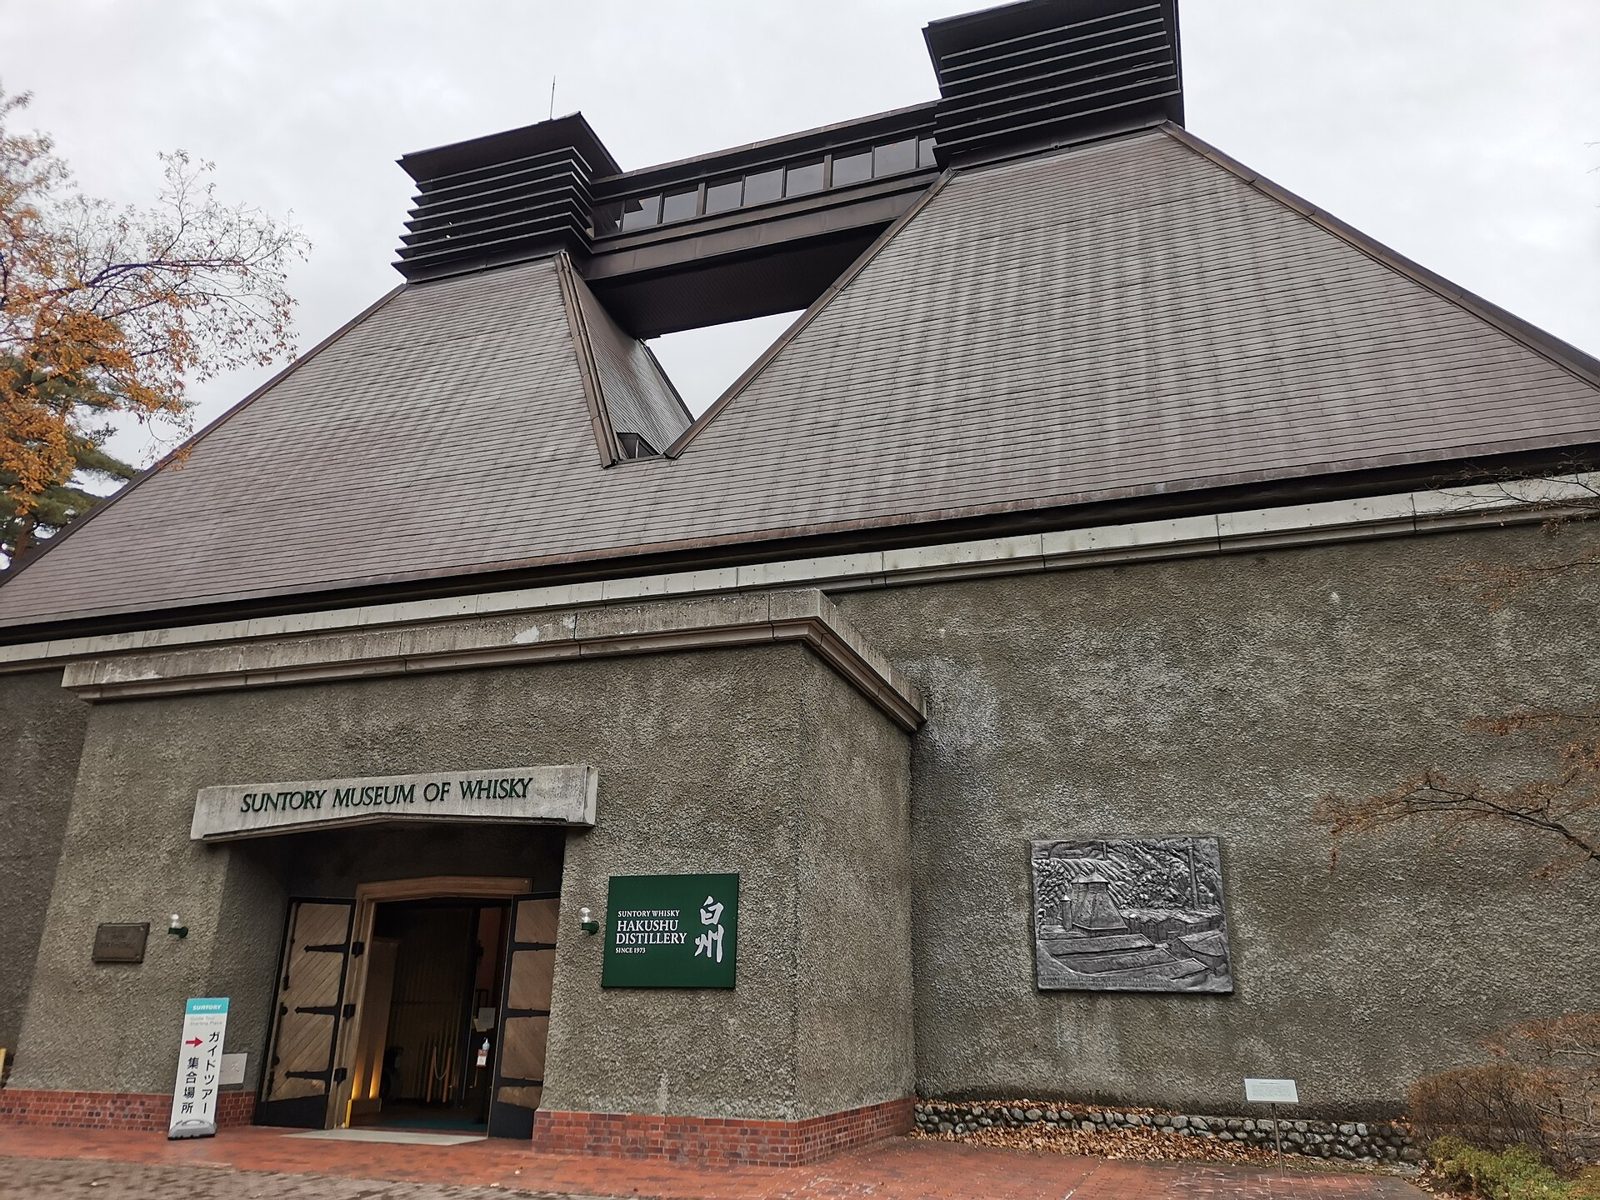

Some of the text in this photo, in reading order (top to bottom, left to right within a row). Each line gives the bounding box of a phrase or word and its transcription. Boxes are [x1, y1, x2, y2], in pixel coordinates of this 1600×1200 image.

[240, 777, 534, 813] SUNTORY MUSEUM OF WHISKY
[617, 909, 680, 918] SUNTORY WHISKY
[616, 920, 679, 932] HAKUSHU
[694, 895, 725, 963] 白州
[615, 932, 688, 945] DISTILLERY
[192, 1003, 222, 1011] SUNTORY
[201, 1031, 221, 1114] ガイドツアー
[181, 1057, 200, 1115] 集合場所
